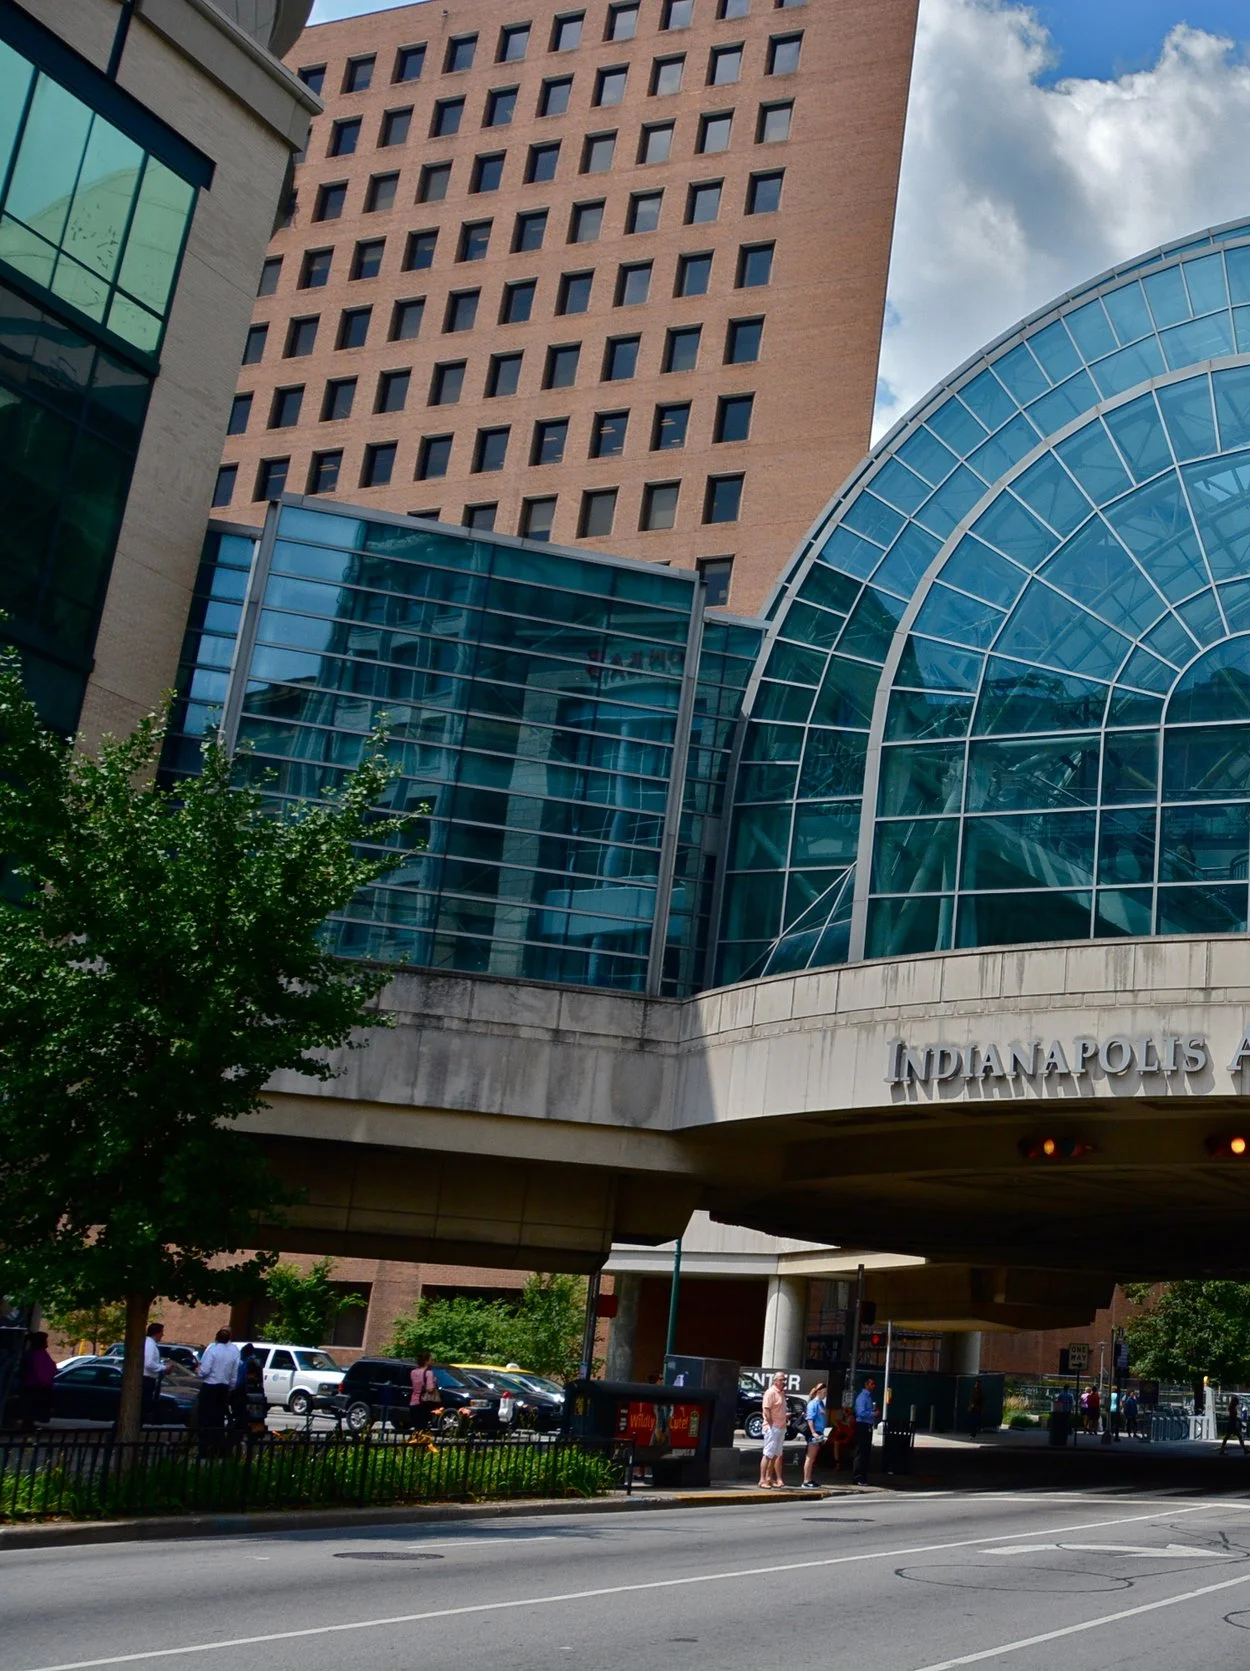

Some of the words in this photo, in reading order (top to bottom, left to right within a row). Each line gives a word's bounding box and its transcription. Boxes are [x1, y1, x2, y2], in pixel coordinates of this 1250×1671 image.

[885, 1034, 1208, 1083] INDIANAPOLIS
[630, 1413, 657, 1431] Wildly
[669, 1415, 689, 1430] Cute!
